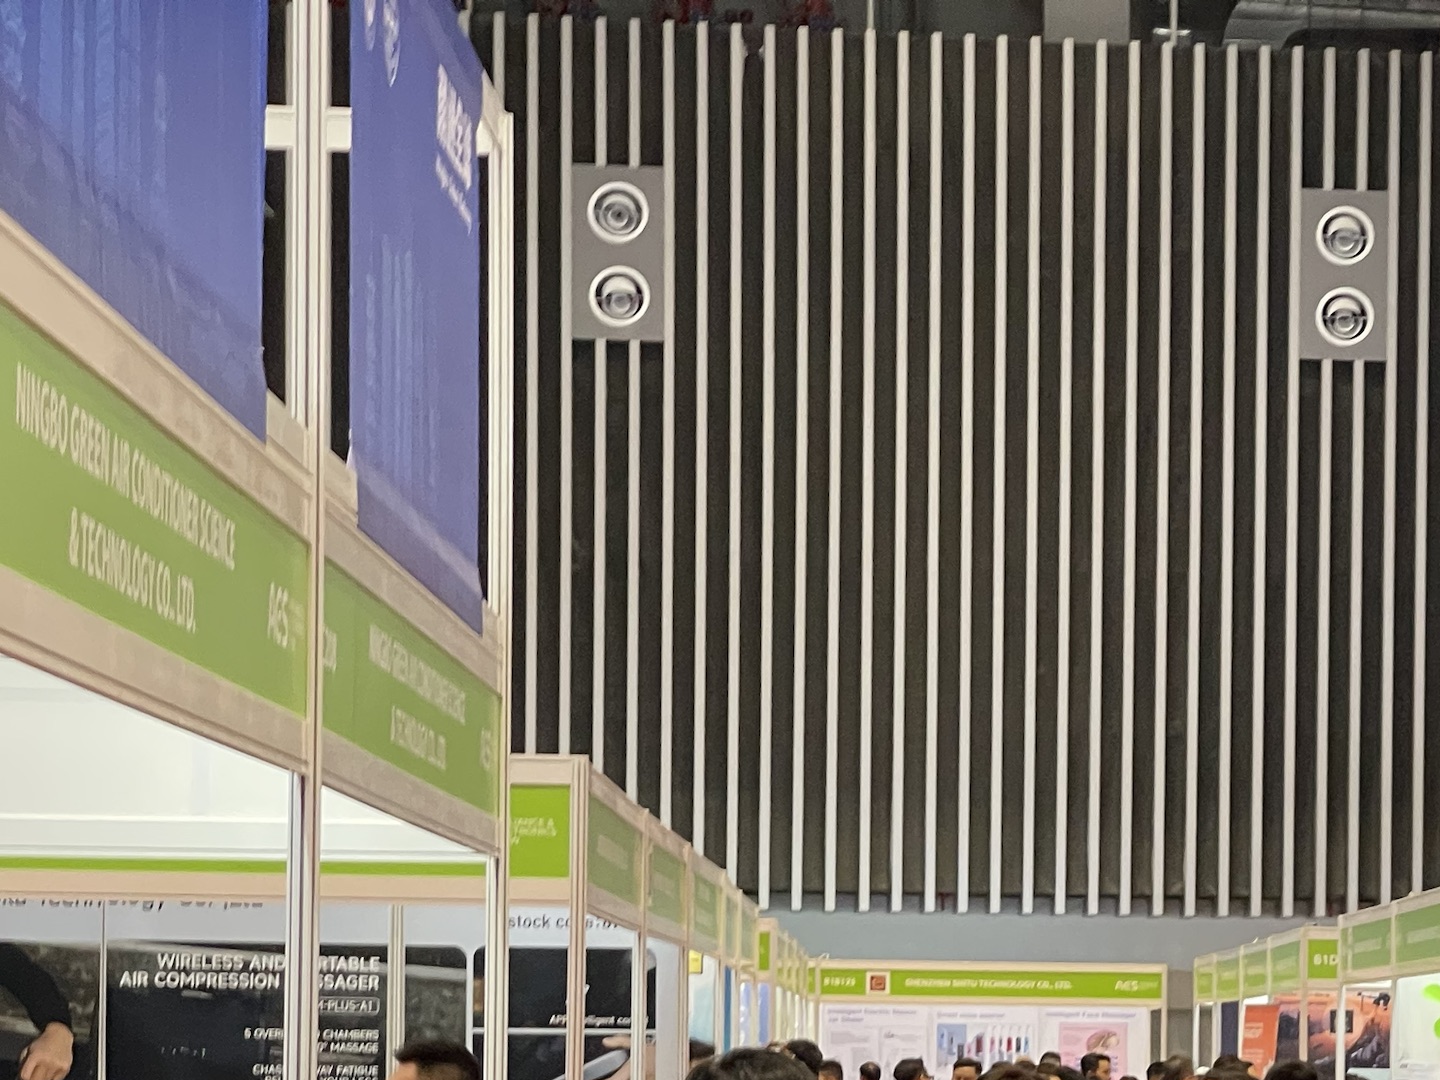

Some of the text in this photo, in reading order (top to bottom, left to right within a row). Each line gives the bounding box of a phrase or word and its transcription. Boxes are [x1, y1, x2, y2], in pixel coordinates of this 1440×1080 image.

[15, 362, 68, 456] NINGBO
[69, 404, 110, 488] GREEN
[110, 432, 131, 501] AIR
[131, 447, 200, 549] CONDITIONER
[80, 511, 156, 611] TECHNOLOGY
[119, 970, 149, 989] AIR
[154, 971, 280, 990] COMPRESSION
[157, 952, 380, 973] WIRELESS AND RTABLE
